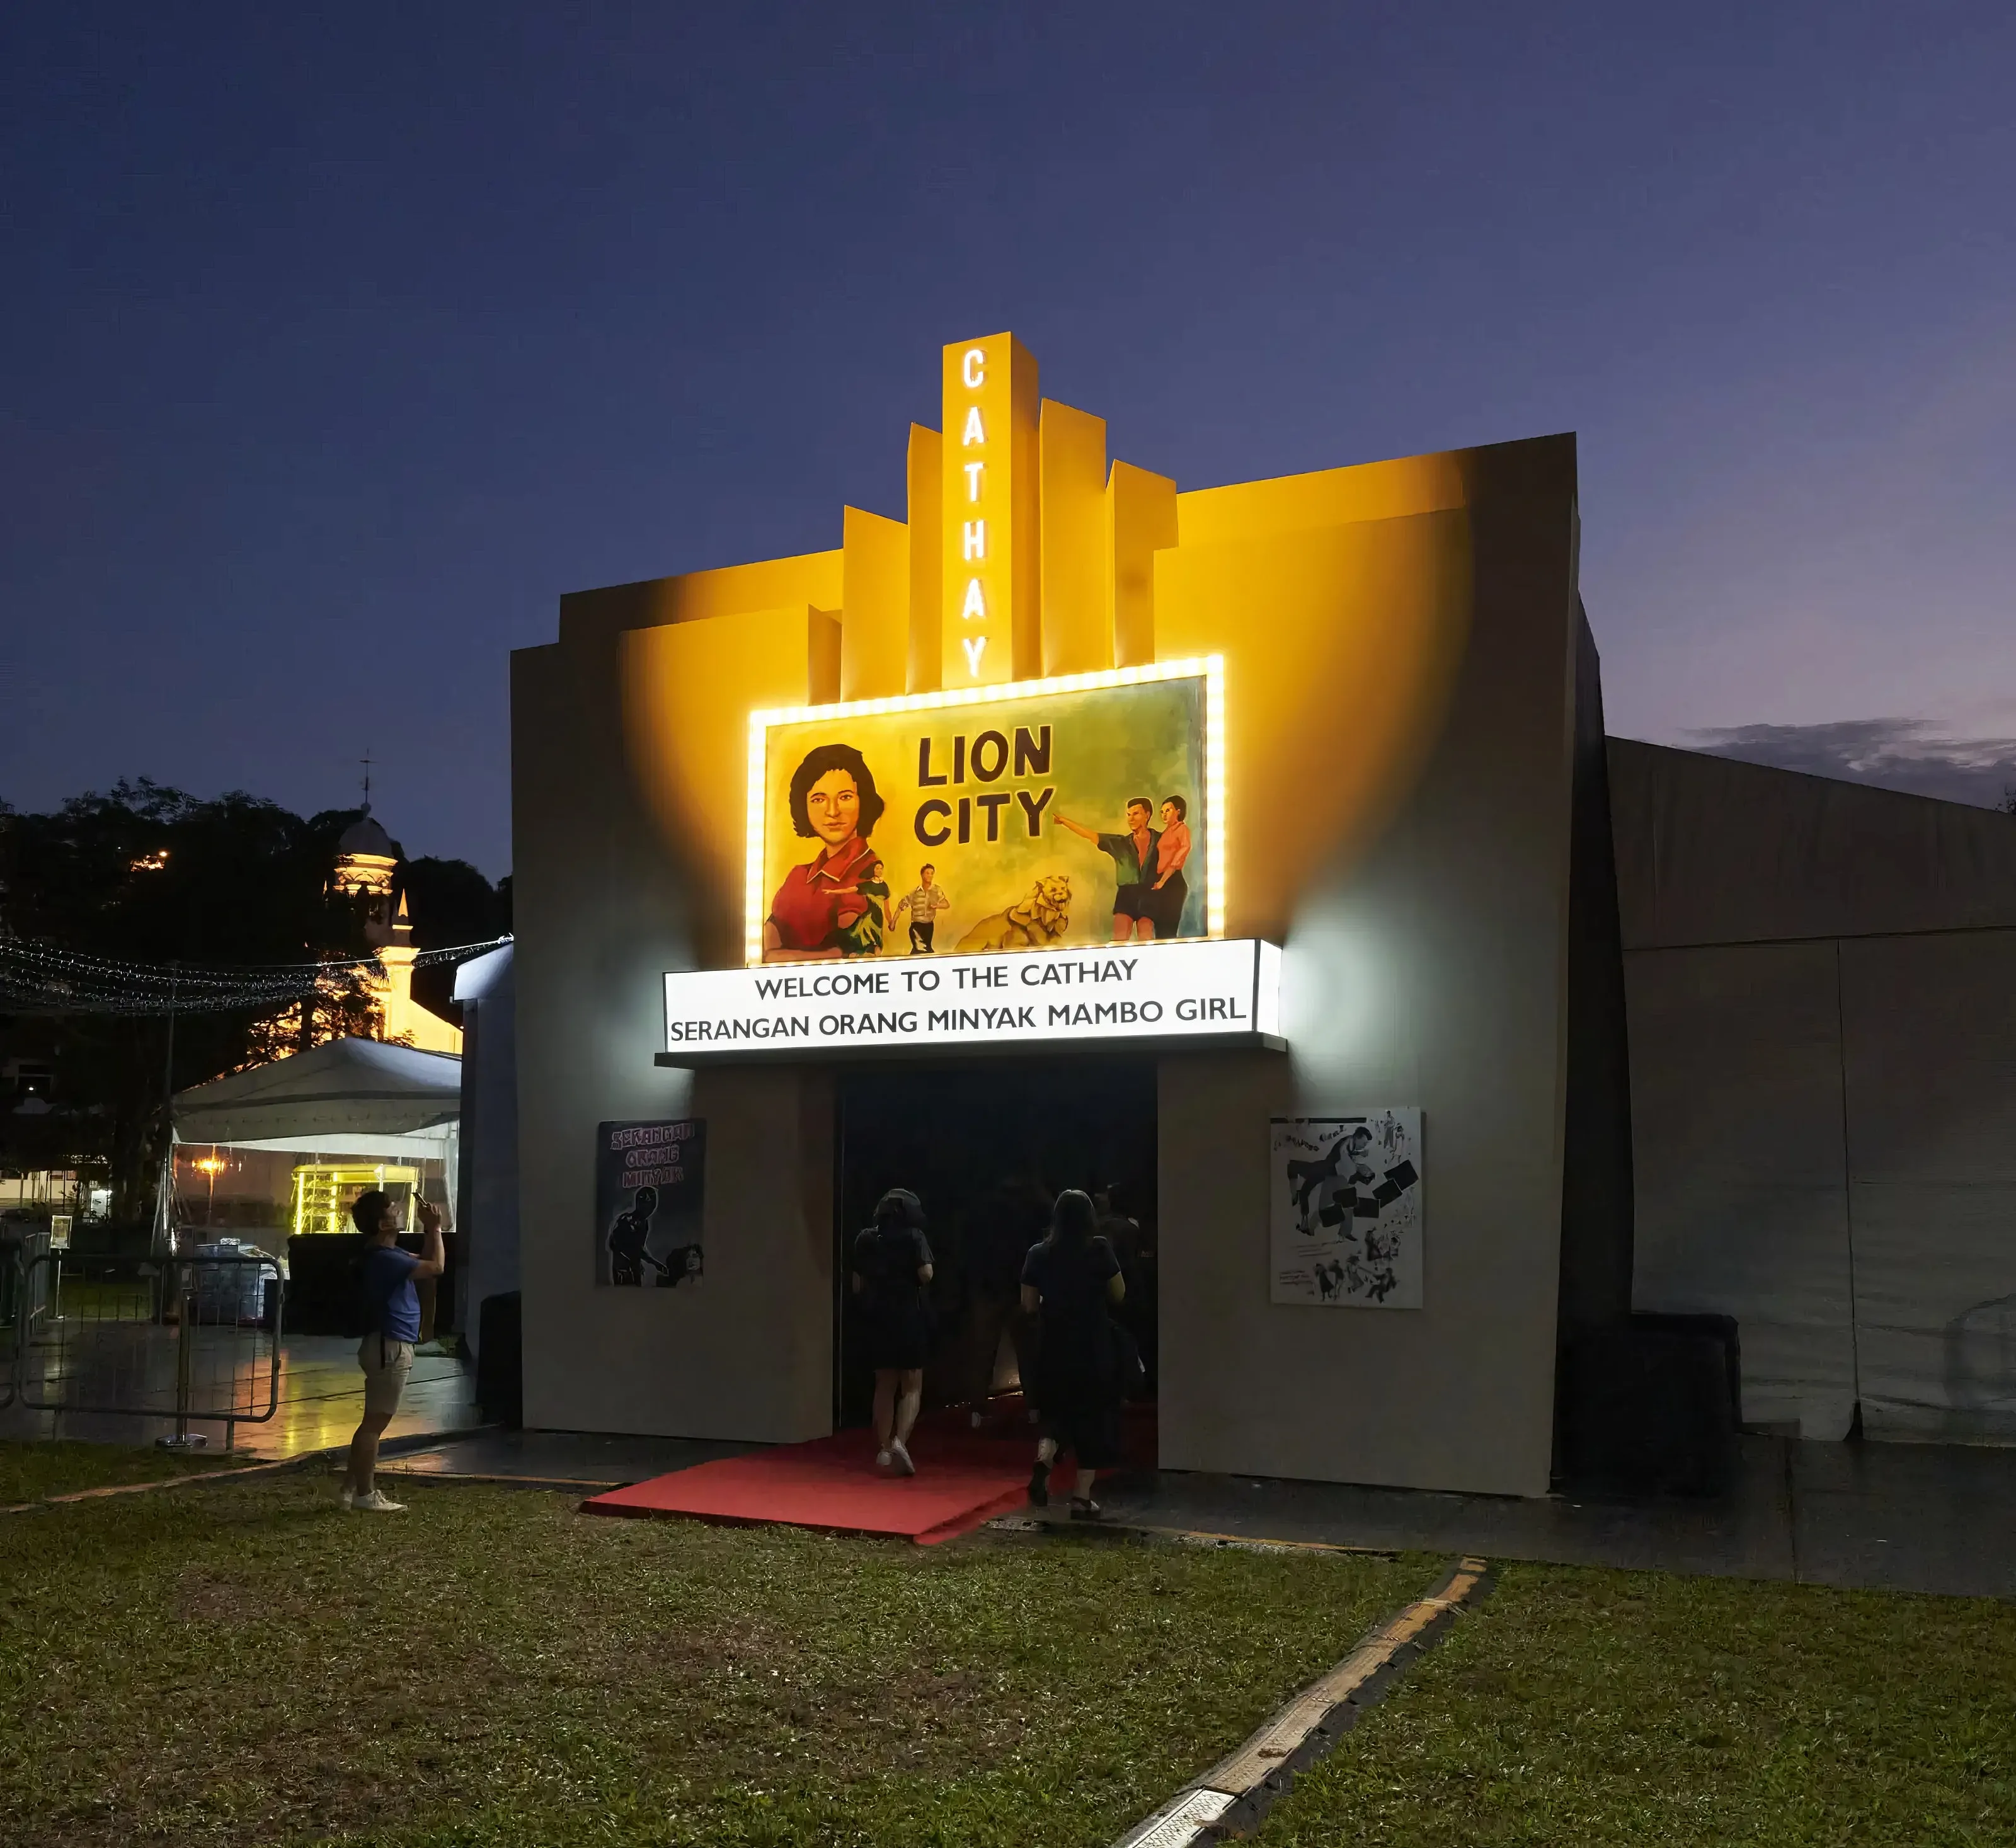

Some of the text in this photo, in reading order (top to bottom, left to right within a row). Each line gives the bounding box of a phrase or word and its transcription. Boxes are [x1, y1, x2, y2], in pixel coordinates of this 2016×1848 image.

[962, 348, 987, 677] CATHAY
[918, 725, 1051, 788] LION
[914, 788, 1055, 847] CITY
[755, 958, 1138, 1001] WELCOME TO THE CATHAY
[671, 997, 1247, 1042] SERANGAN ORANG MINYAK MAMBO GIRL
